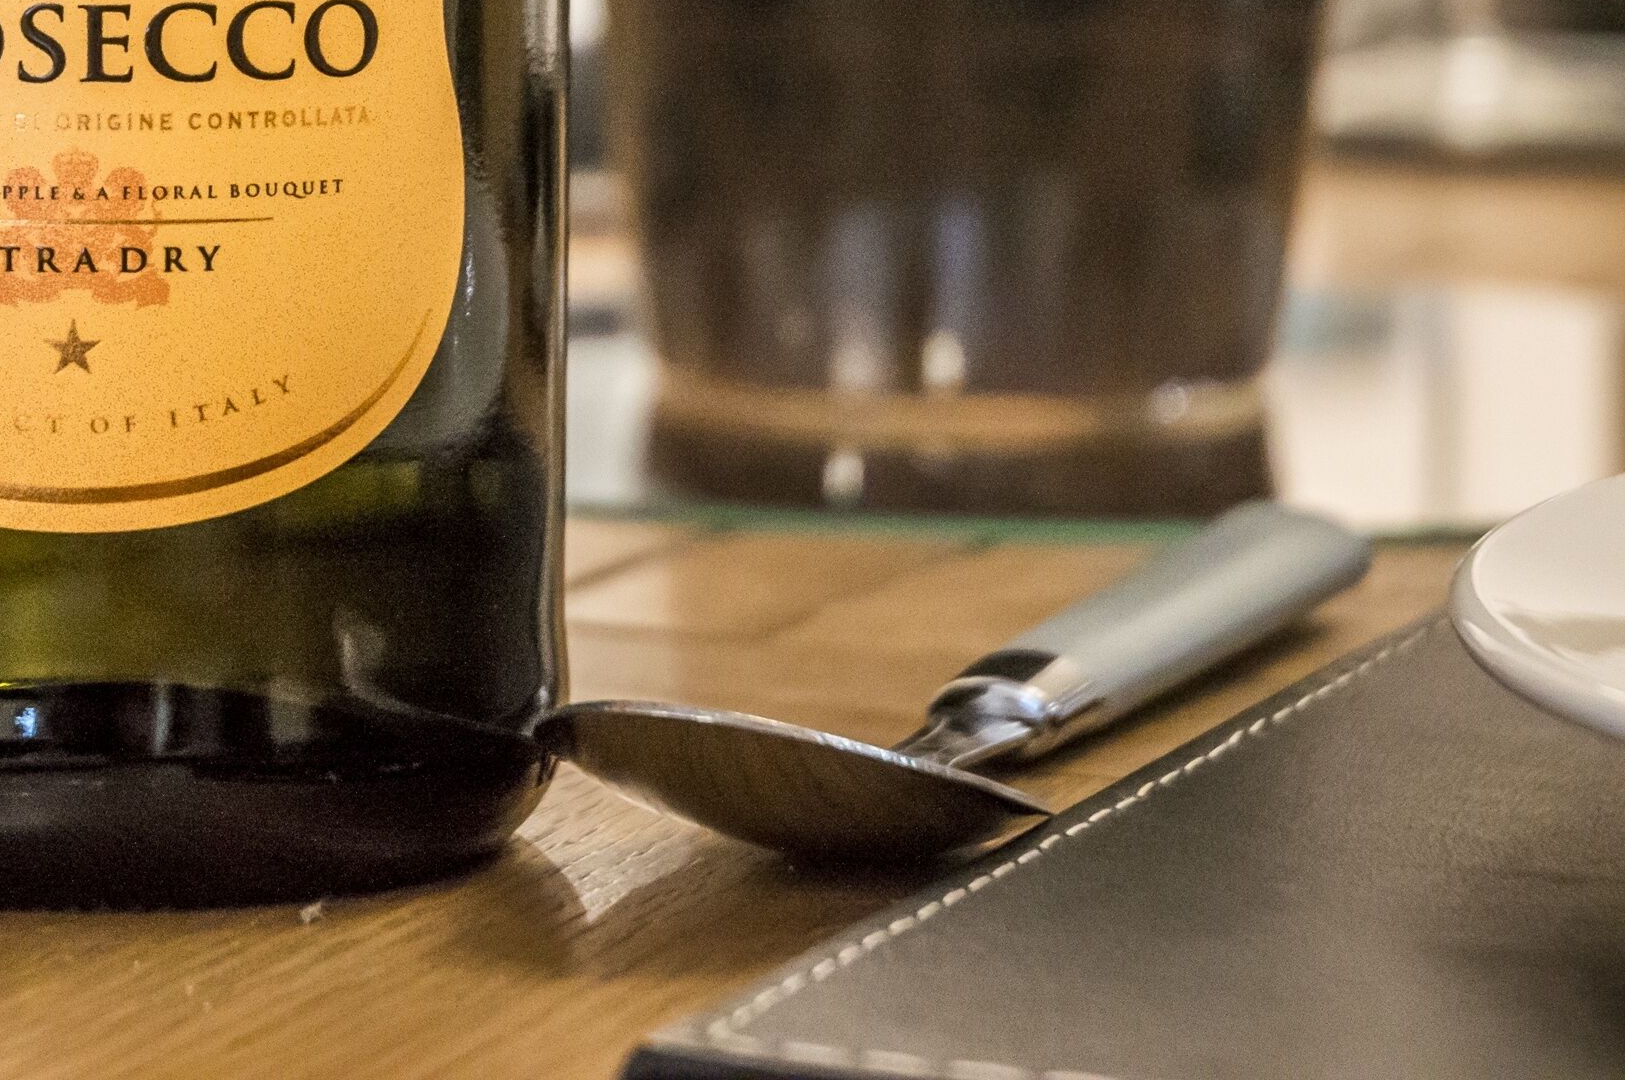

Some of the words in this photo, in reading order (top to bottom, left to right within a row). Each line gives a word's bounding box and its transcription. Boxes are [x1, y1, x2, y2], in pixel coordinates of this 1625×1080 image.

[55, 111, 174, 131] ORIGINE
[187, 105, 371, 131] CONTROLLATA
[71, 185, 86, 201] &
[96, 185, 109, 201] A
[122, 184, 218, 200] FLORAL
[229, 178, 344, 199] BOUQUET
[89, 414, 138, 435] OF
[168, 373, 292, 430] ITALY
